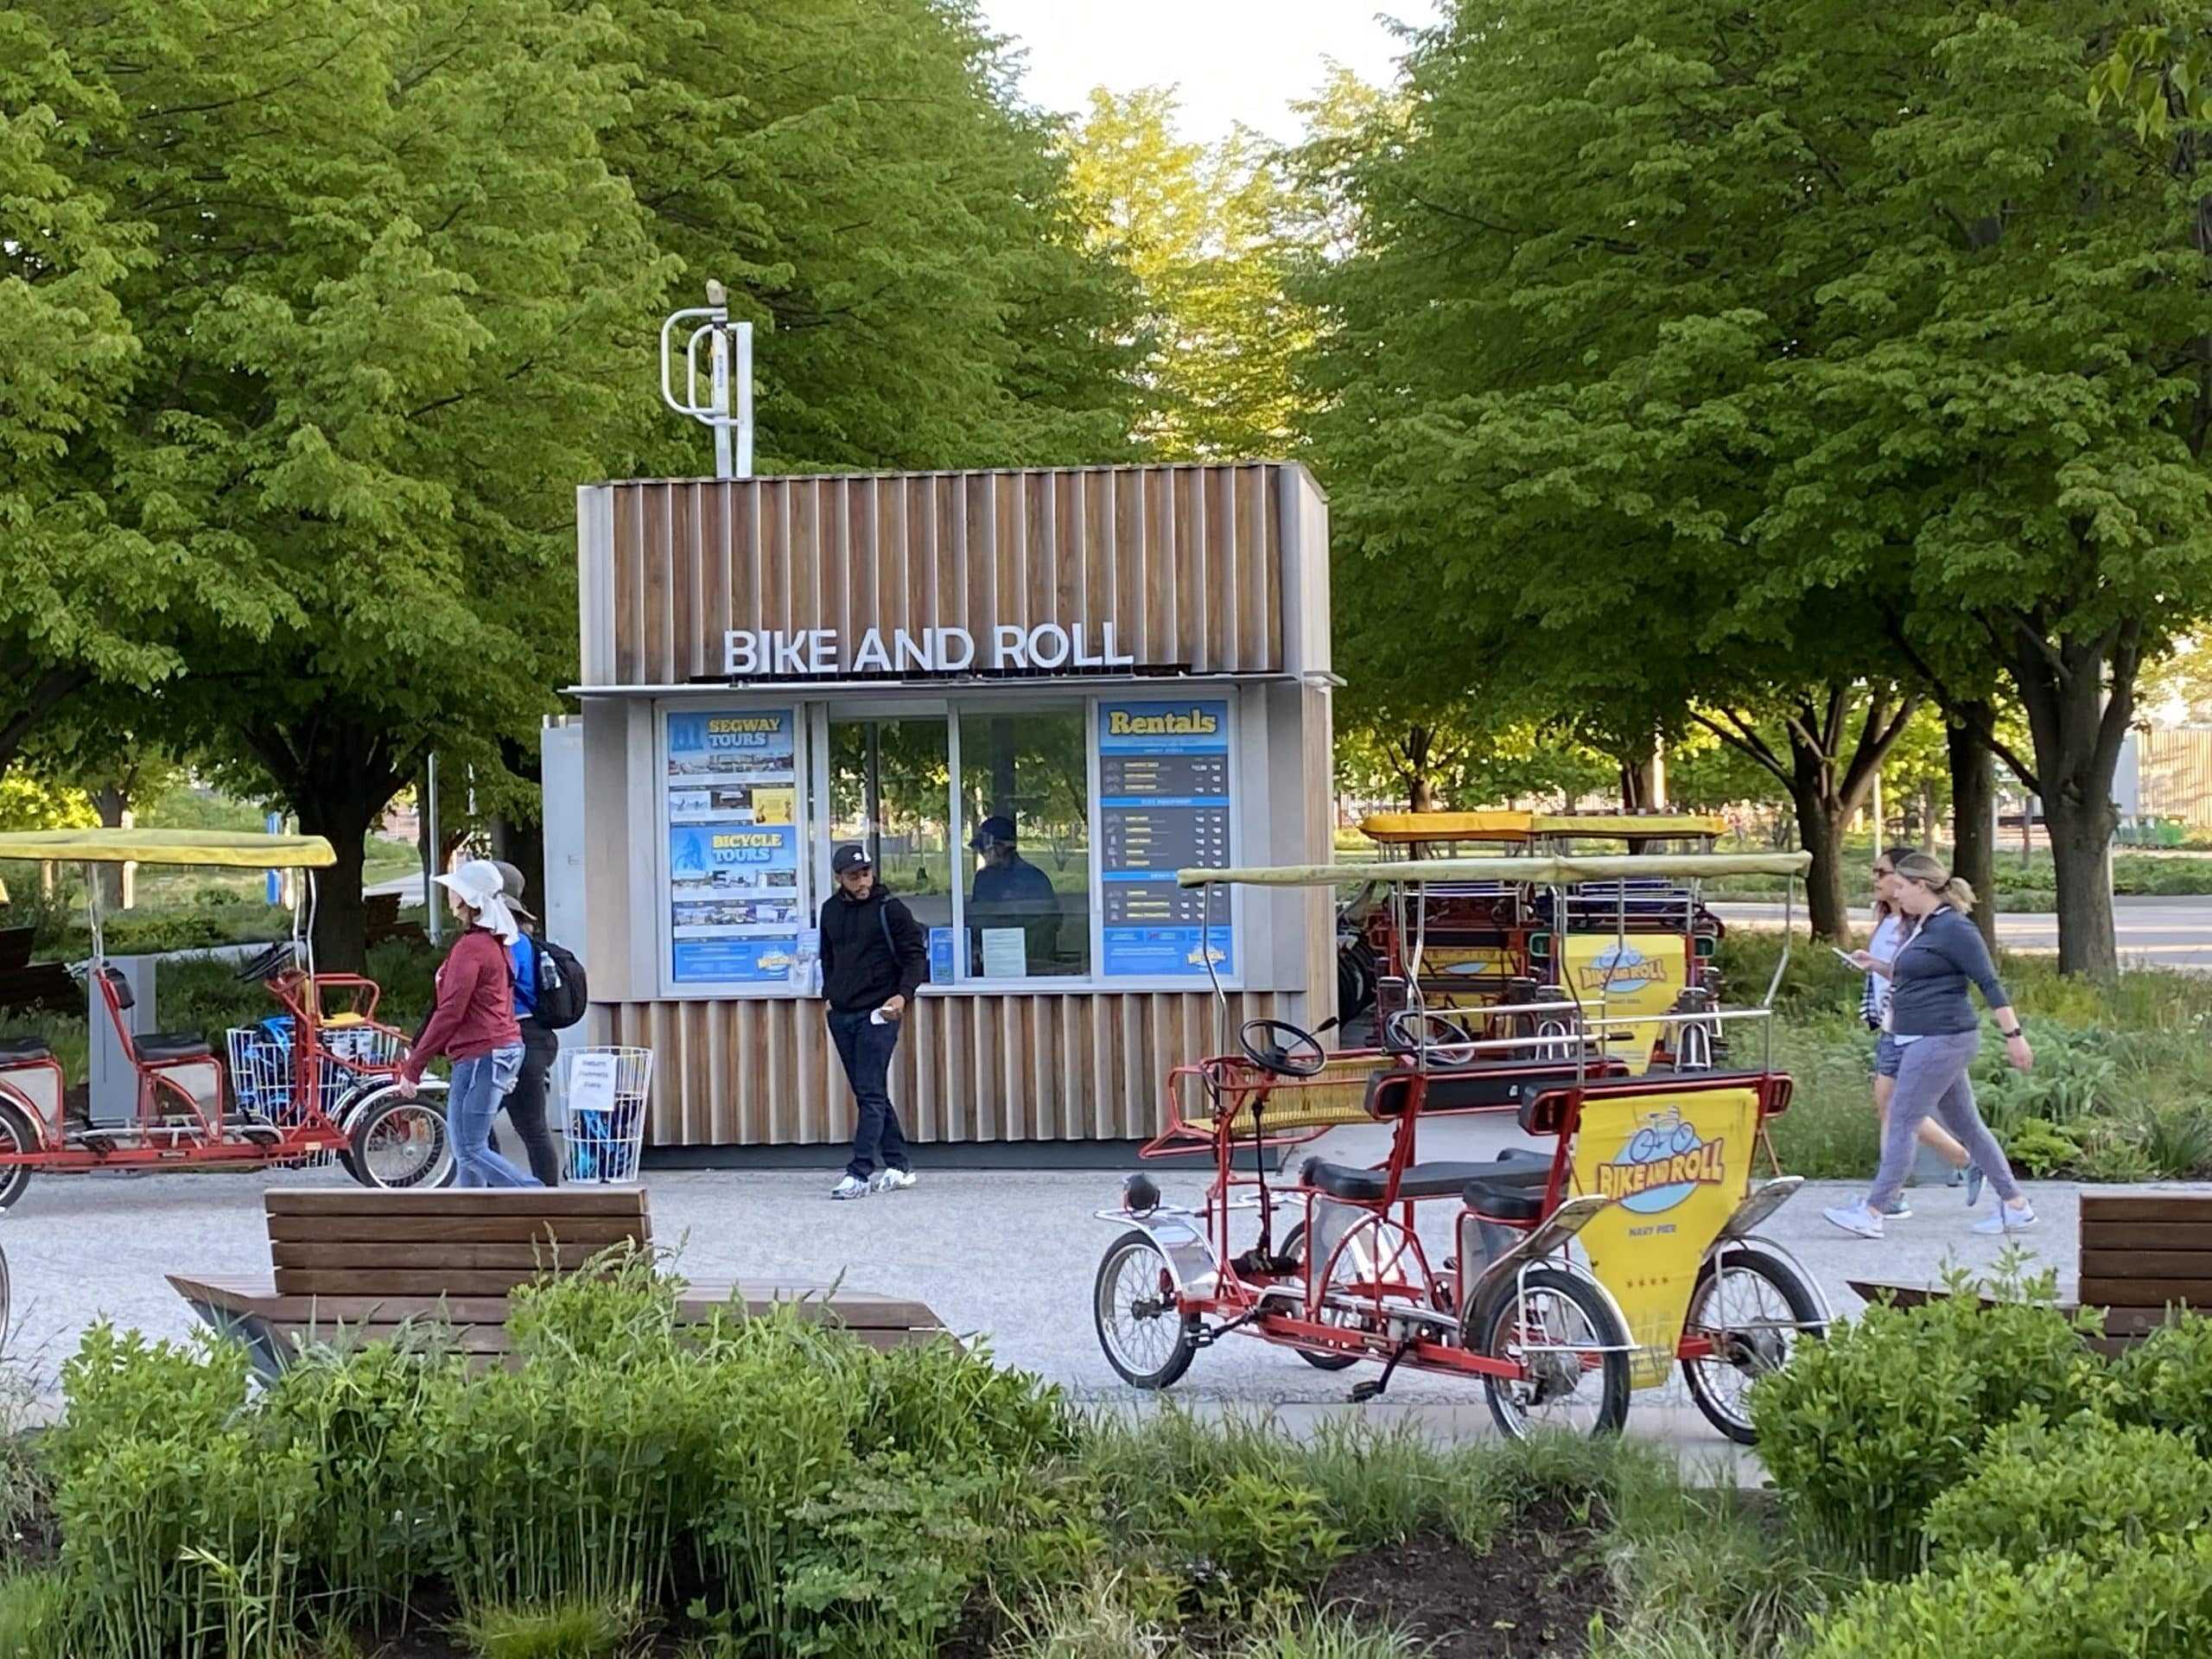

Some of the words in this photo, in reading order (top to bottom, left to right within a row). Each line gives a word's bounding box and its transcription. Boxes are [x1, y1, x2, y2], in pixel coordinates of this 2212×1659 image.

[723, 629, 838, 674] BIKE
[853, 626, 975, 672] AND
[994, 621, 1135, 670] ROLL
[709, 717, 781, 734] SEGWAY
[1109, 709, 1217, 734] Rentals
[709, 733, 766, 747] TOURS
[712, 834, 783, 849] BICYCLE
[712, 848, 771, 862] TOURS
[1598, 1162, 1647, 1202] BIKE
[1669, 1137, 1725, 1185] ROLL
